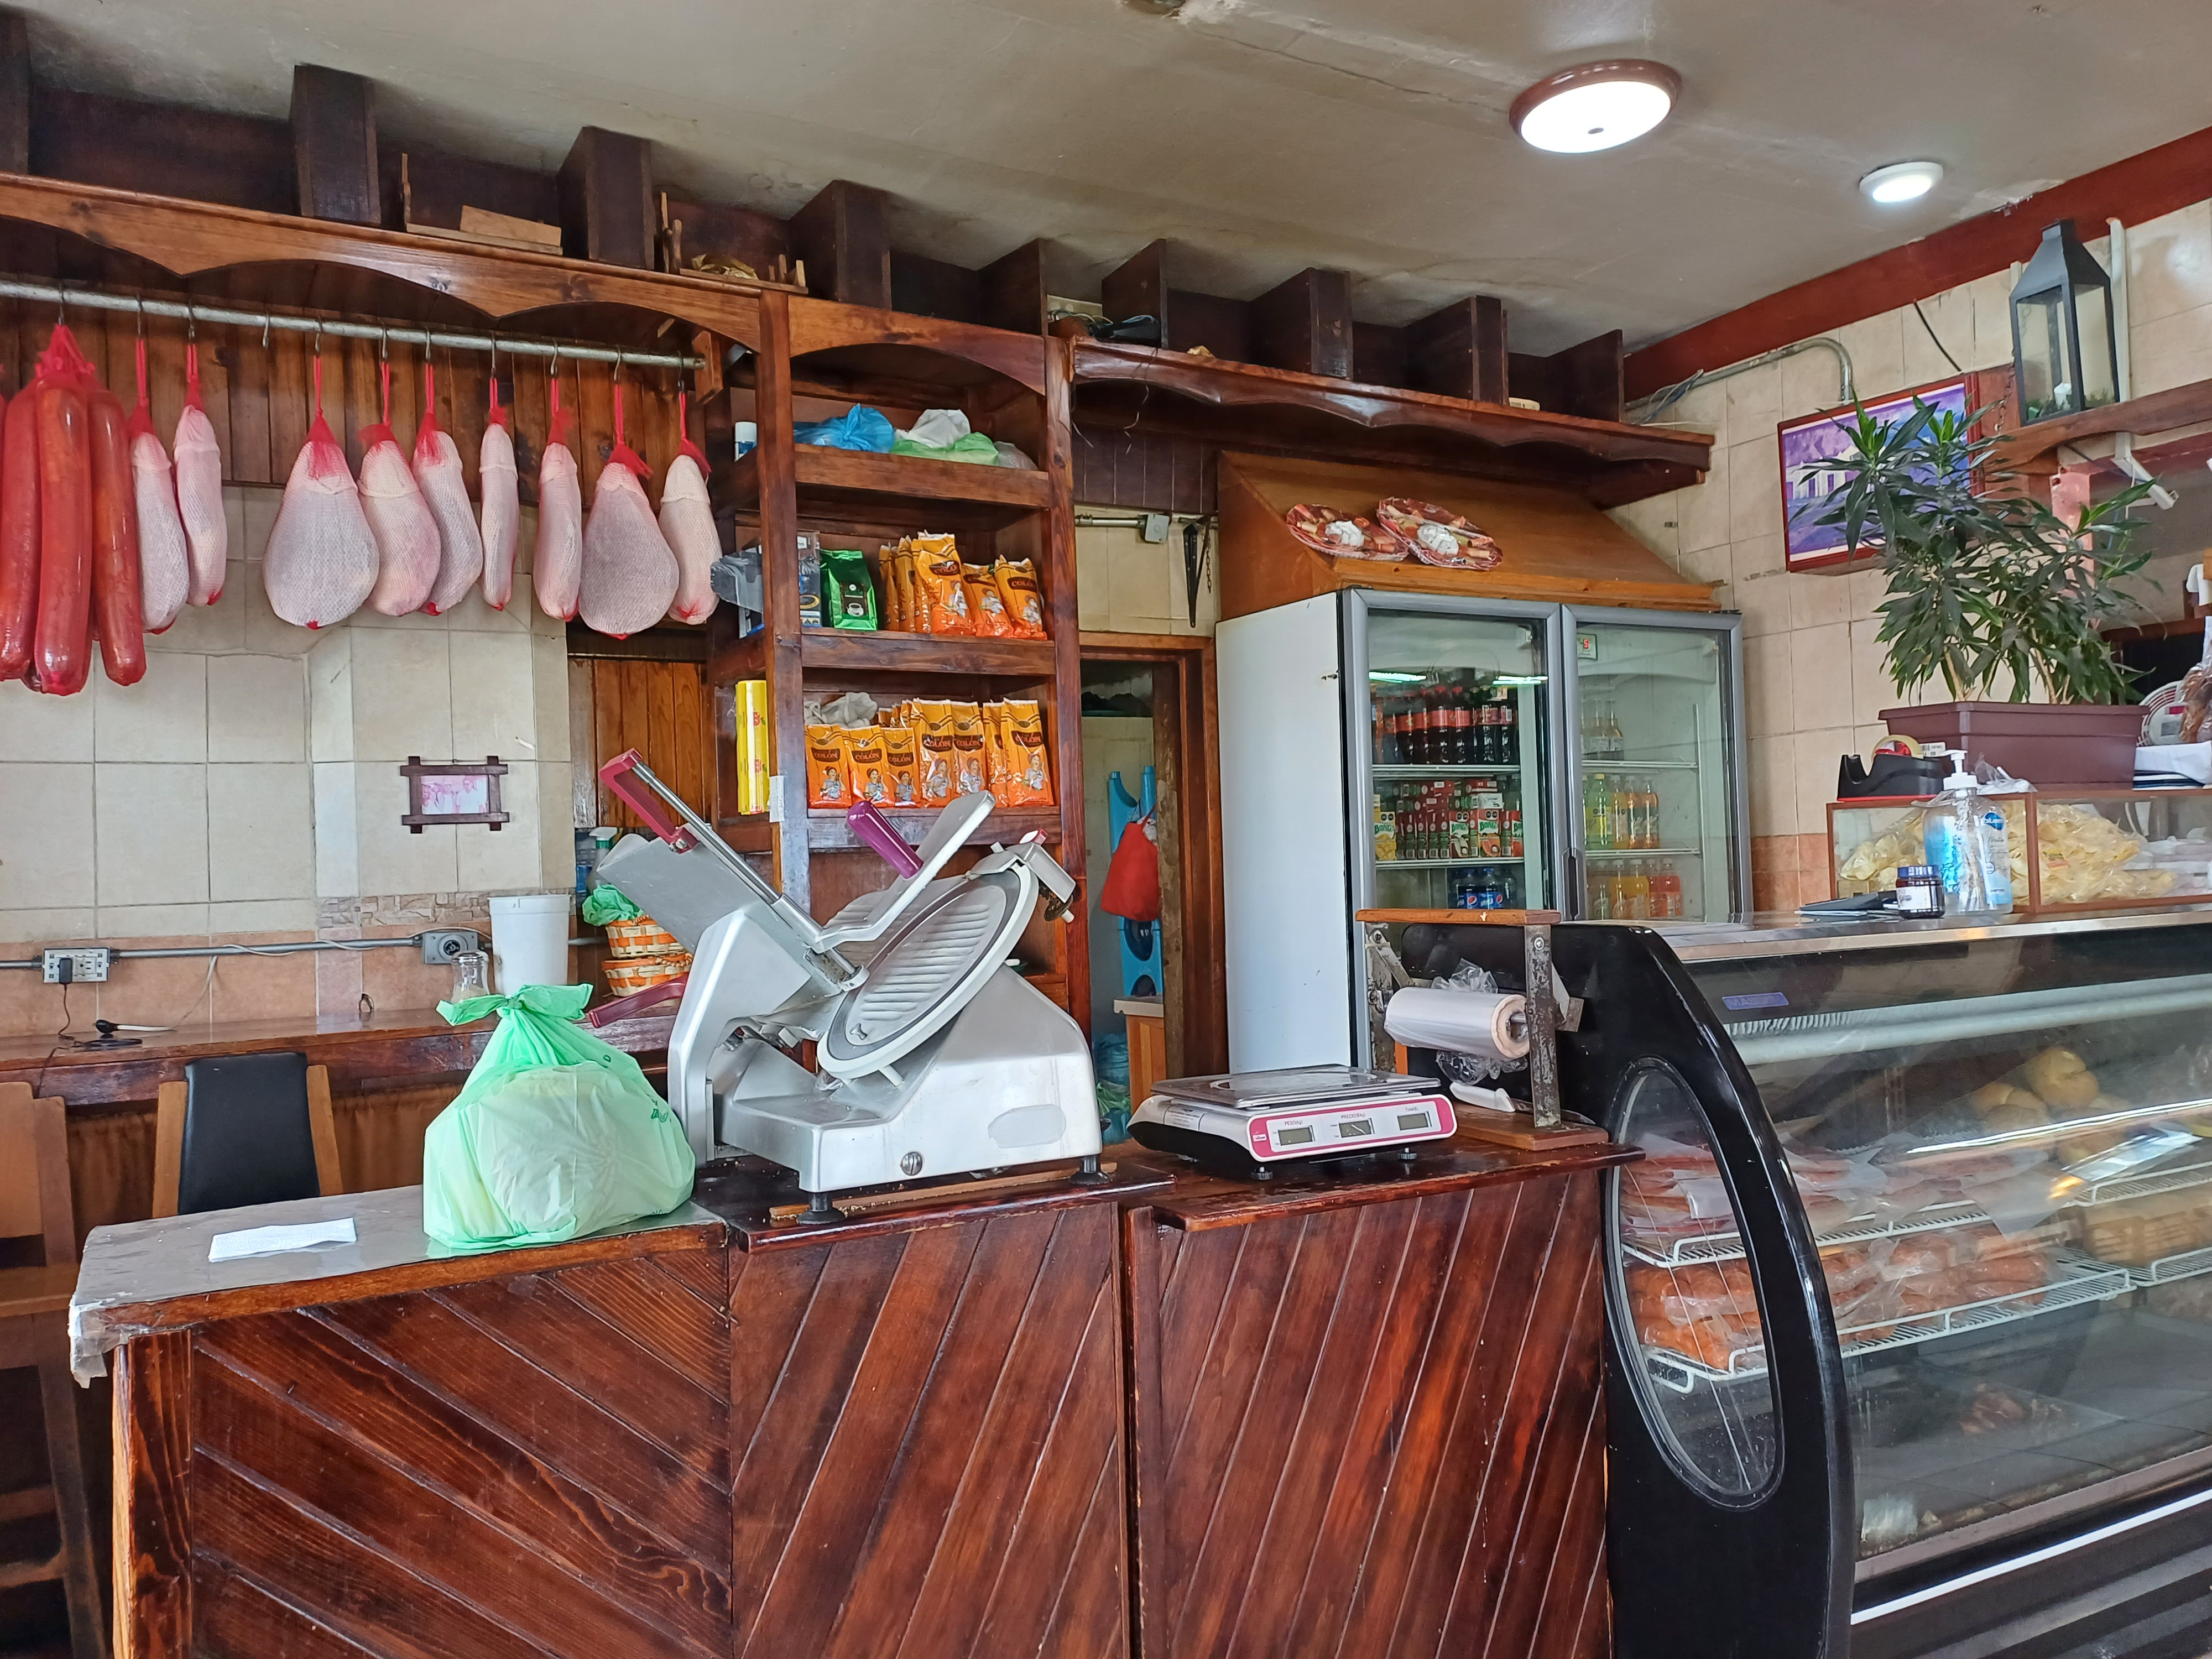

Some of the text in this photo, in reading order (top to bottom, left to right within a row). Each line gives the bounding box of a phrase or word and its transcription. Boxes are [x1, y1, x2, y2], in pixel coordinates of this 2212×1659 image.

[926, 736, 951, 747] OLÓN
[956, 736, 980, 746] COLÓN
[814, 749, 838, 759] COLÓN
[855, 750, 880, 760] COLÓN
[889, 753, 911, 763] COLÓN
